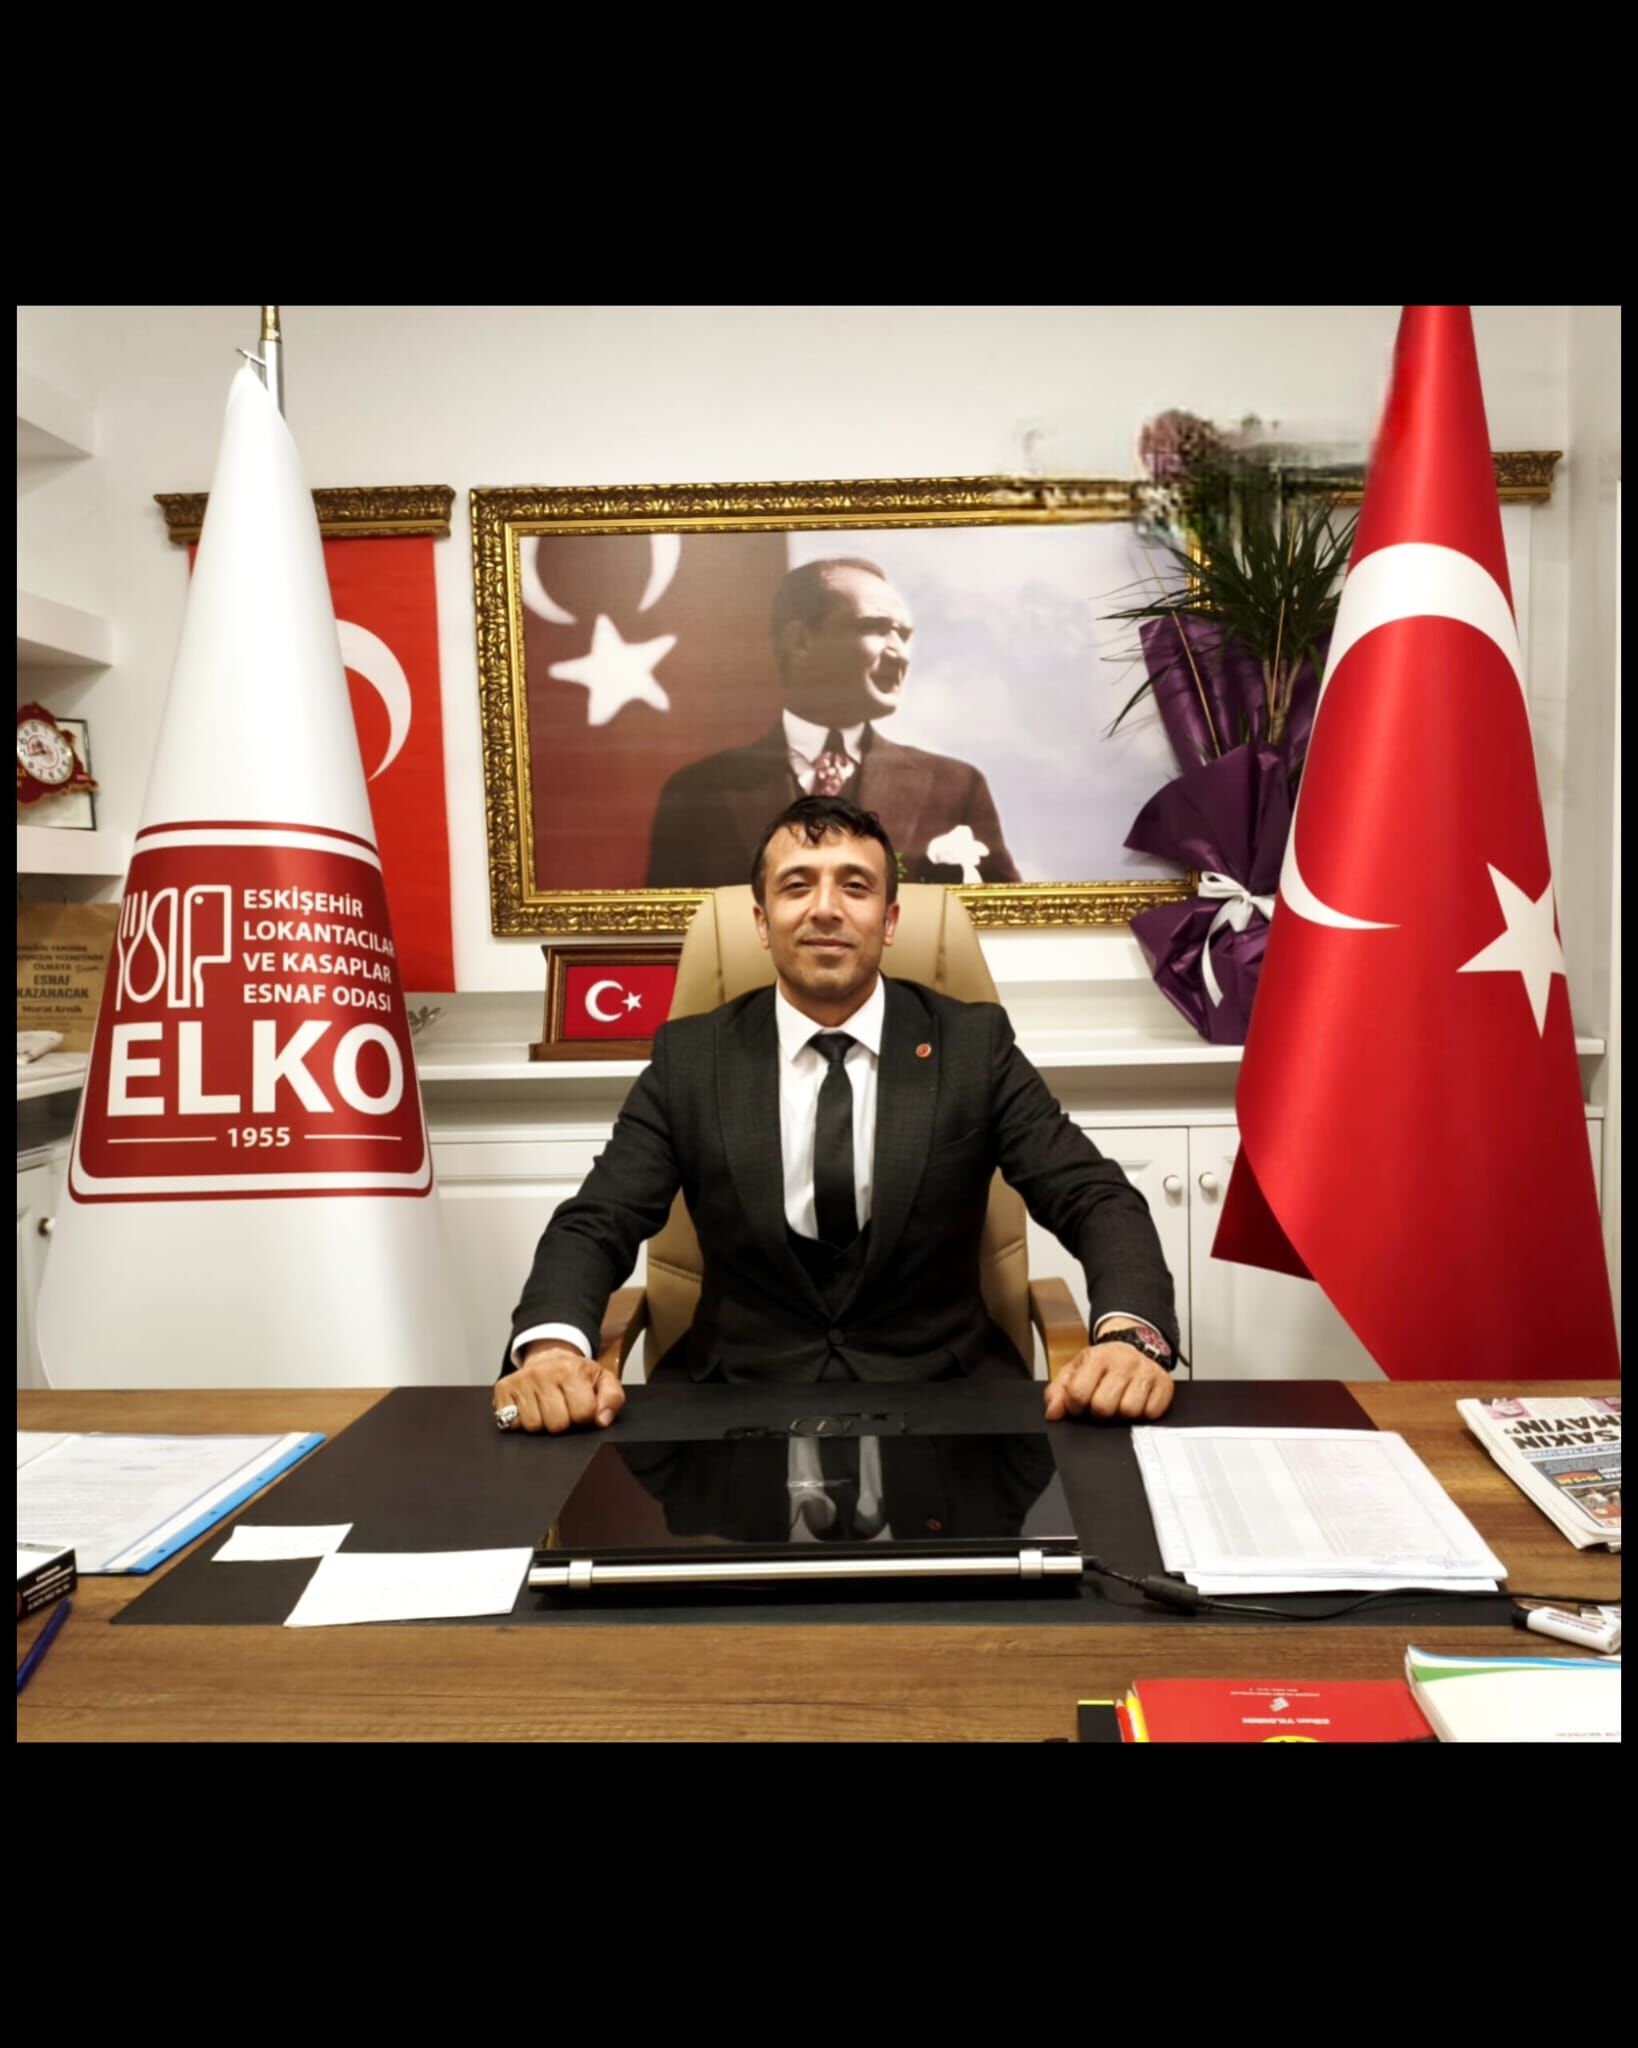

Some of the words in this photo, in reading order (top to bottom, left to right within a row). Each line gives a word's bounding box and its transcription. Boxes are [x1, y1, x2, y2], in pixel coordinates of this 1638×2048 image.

[243, 886, 363, 918] ESKİŞEHİR
[243, 920, 395, 958] LOKANTACILAR
[33, 974, 70, 985] ESNAF
[243, 952, 275, 972] VE
[282, 953, 392, 984] KASAPLAR
[17, 988, 89, 999] KAZANACAK
[243, 983, 326, 1004] ESNAF
[332, 986, 392, 1013] ODASI
[106, 1019, 405, 1117] ELKO
[227, 1127, 291, 1148] 1955
[1512, 1429, 1620, 1450] SAKIN
